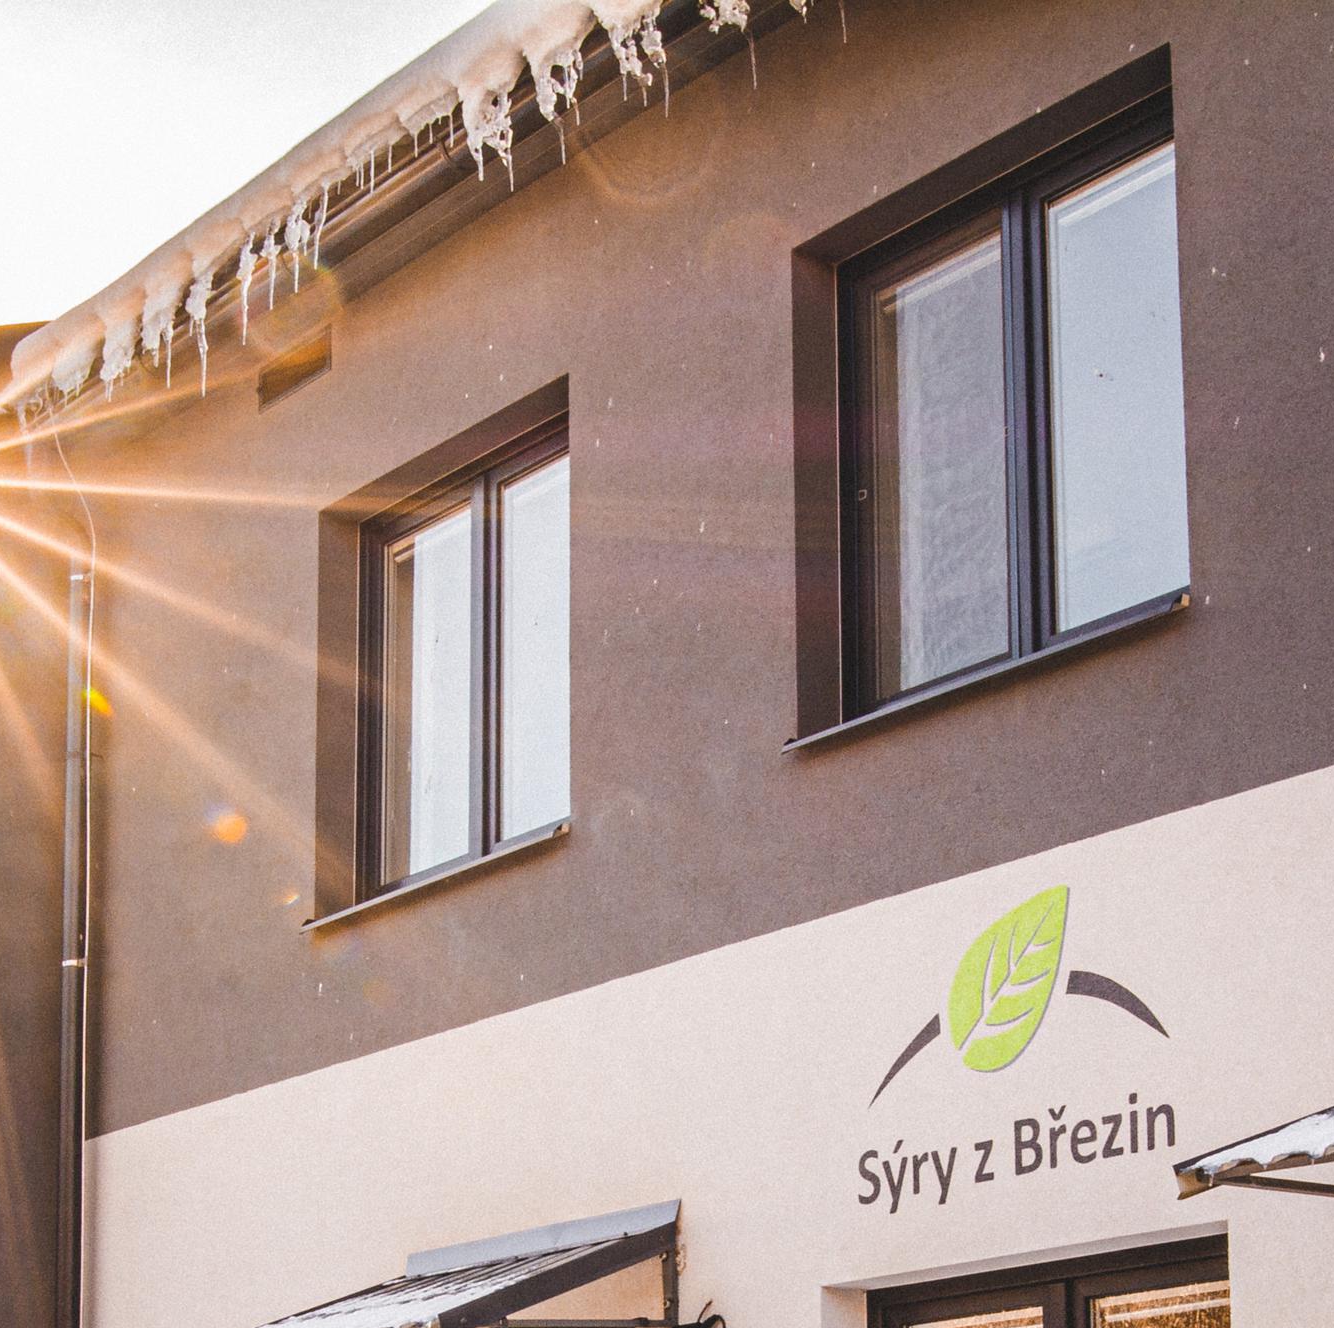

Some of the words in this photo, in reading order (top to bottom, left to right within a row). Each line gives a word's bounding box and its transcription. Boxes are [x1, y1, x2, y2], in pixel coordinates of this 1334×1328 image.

[857, 1138, 958, 1215] Sýry
[973, 1139, 995, 1184] z
[1013, 1091, 1176, 1177] Březin
